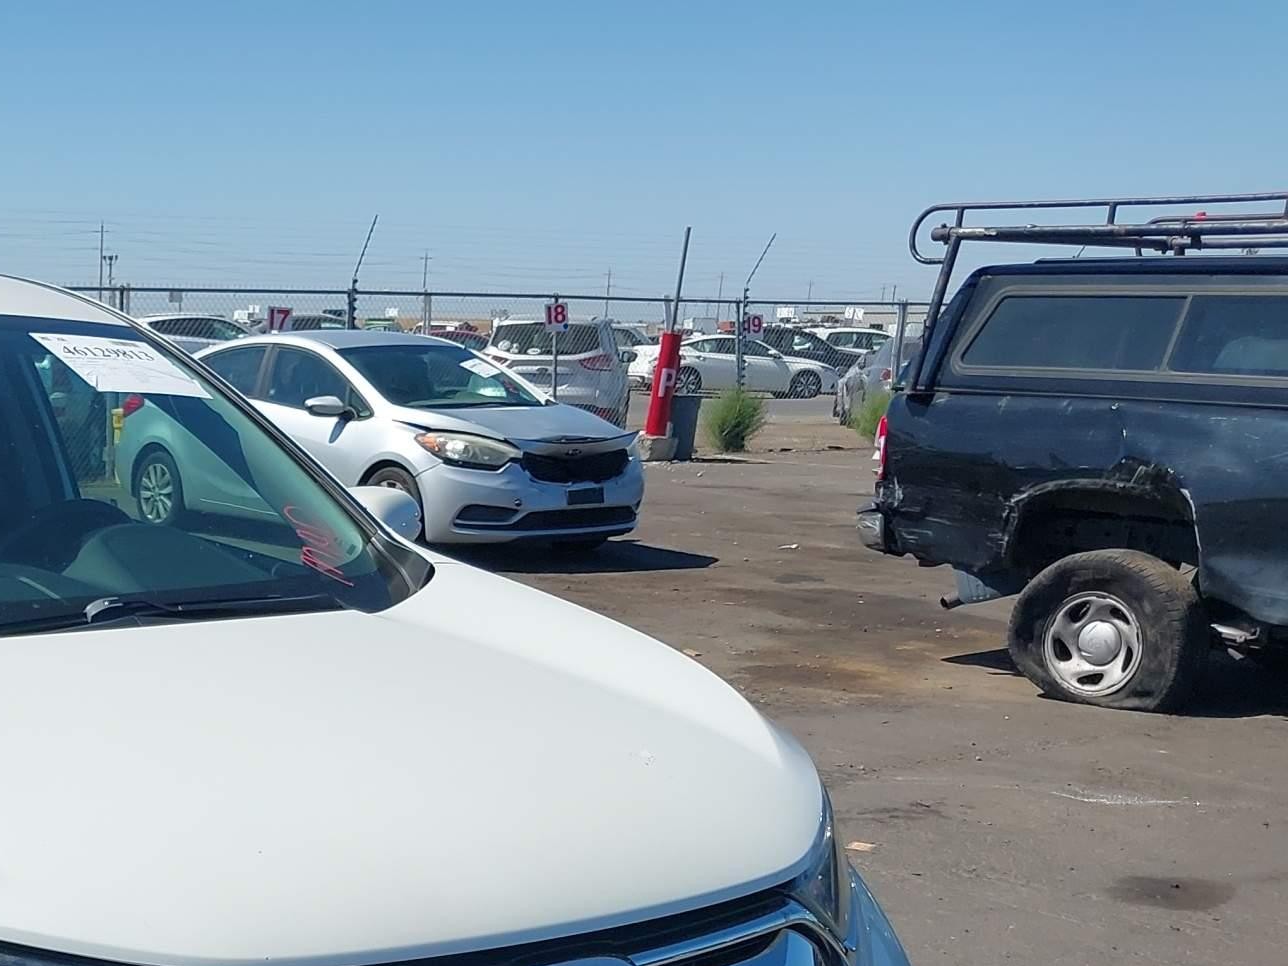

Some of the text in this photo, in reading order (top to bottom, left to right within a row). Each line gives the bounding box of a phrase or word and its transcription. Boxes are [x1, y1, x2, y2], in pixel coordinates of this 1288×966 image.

[269, 309, 290, 330] 17
[547, 304, 566, 325] 18
[745, 316, 762, 334] 19
[62, 345, 155, 362] 46129813
[658, 367, 677, 398] P
